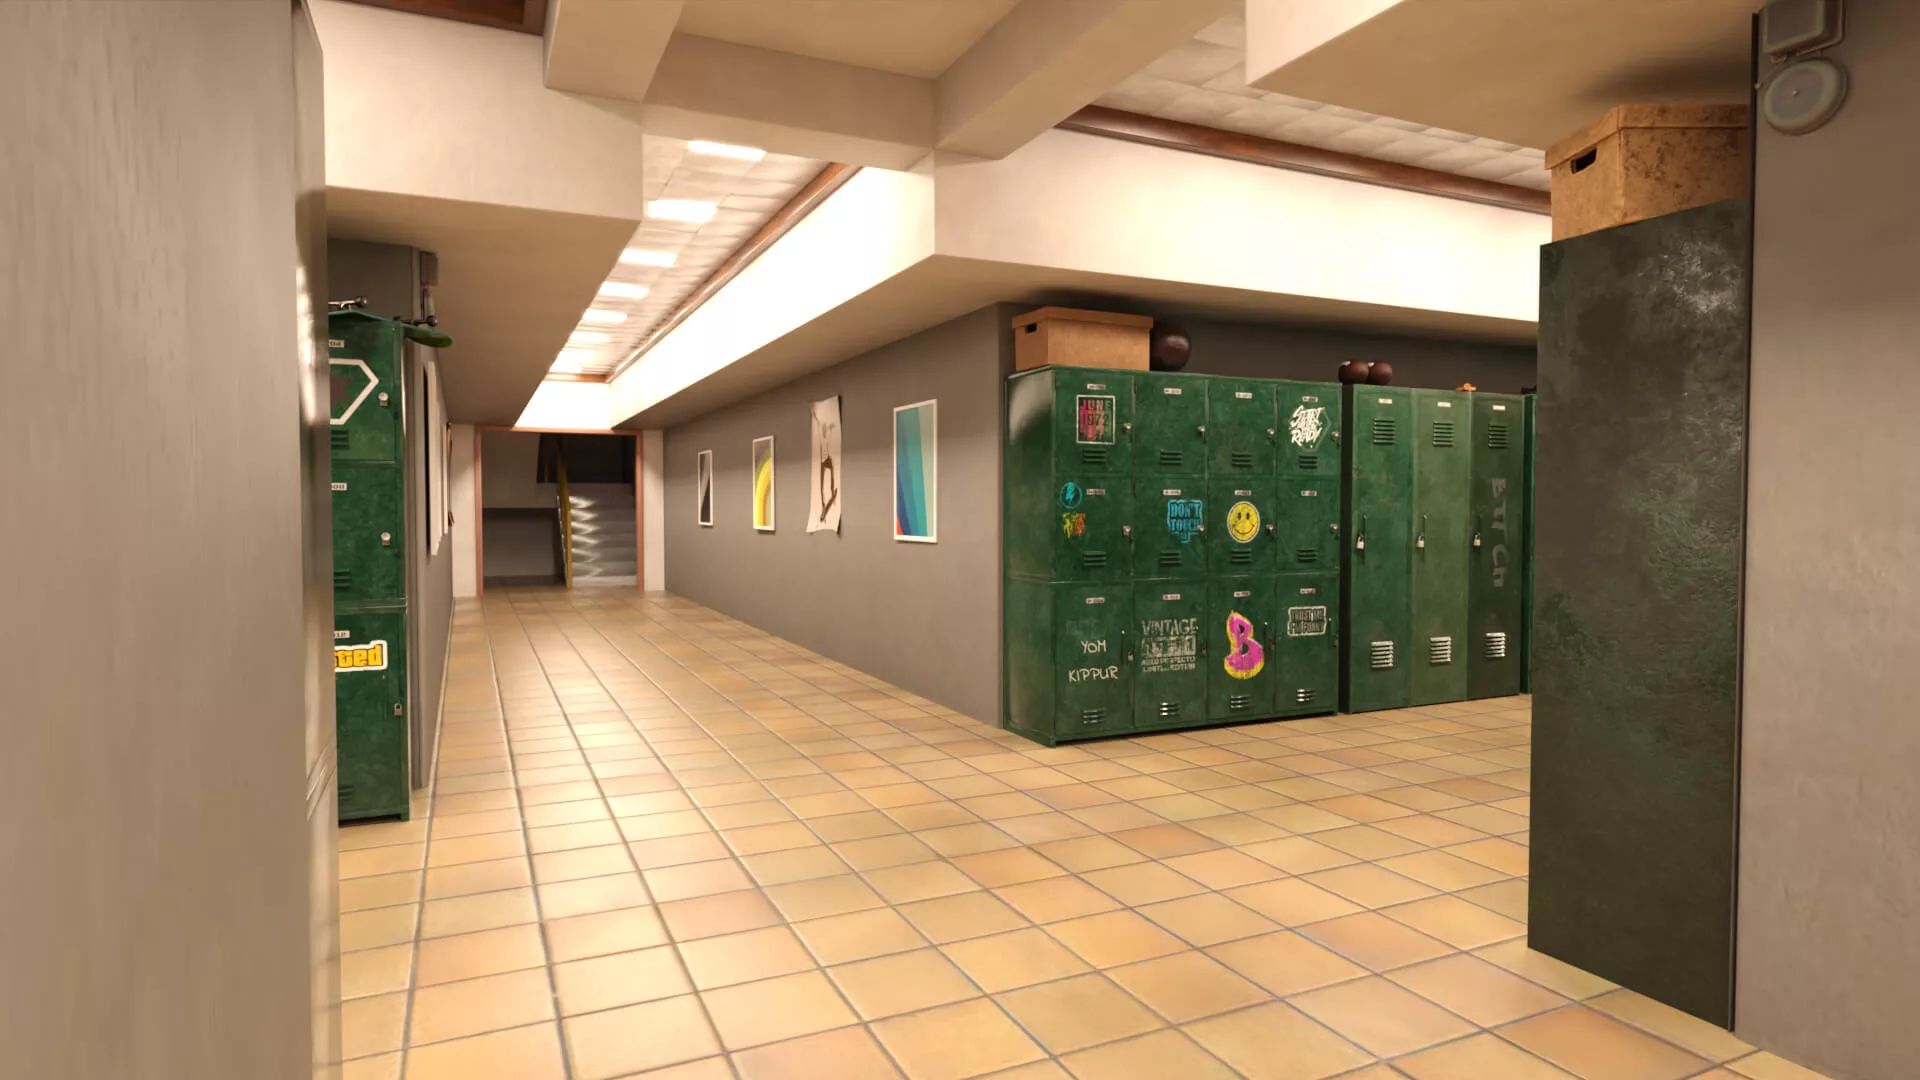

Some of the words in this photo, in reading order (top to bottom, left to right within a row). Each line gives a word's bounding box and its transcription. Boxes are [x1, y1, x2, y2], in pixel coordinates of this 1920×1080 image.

[1080, 399, 1111, 411] JUNE
[1170, 502, 1201, 518] DON'T
[1140, 618, 1197, 636] VINTAGE
[1080, 640, 1107, 654] YOM
[334, 643, 384, 669] ted
[1068, 665, 1119, 683] KIPPUR
